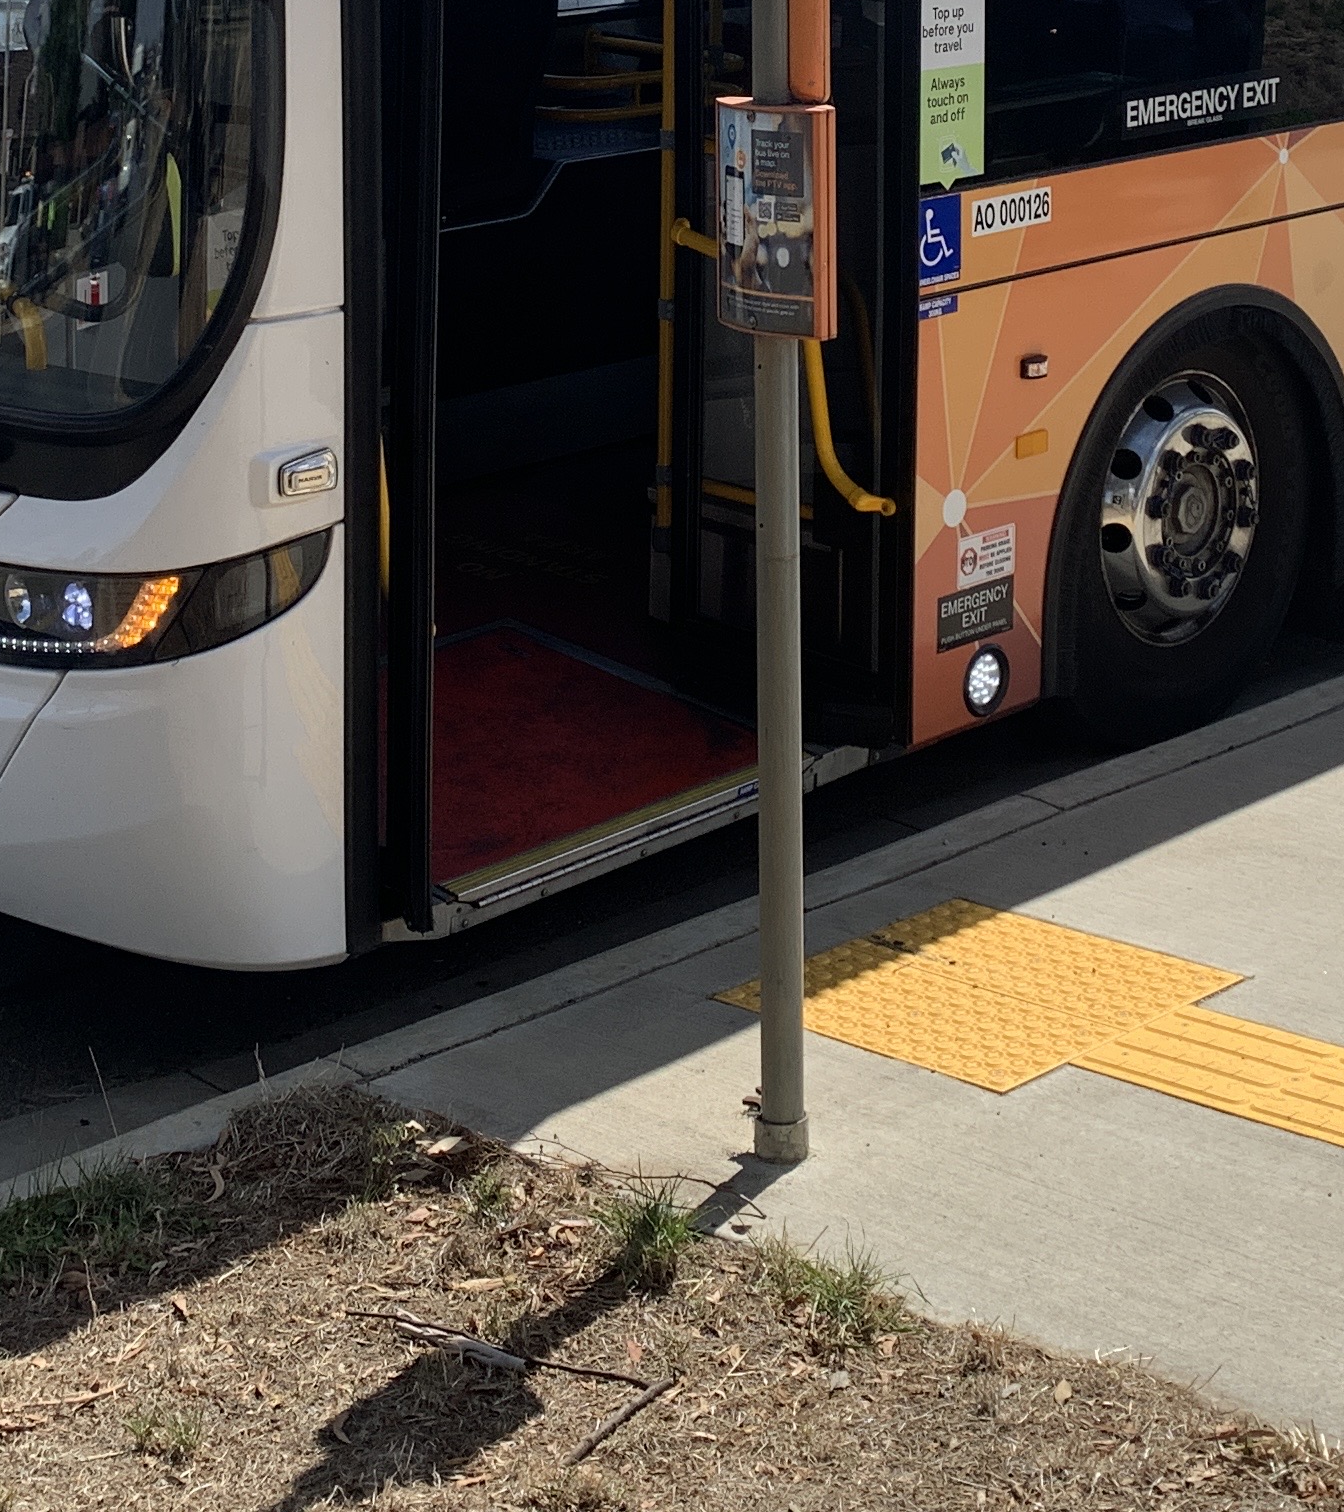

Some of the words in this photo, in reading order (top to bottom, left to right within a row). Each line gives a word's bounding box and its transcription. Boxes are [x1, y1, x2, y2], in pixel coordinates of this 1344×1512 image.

[933, 7, 950, 22] Top
[952, 7, 965, 20] up
[922, 23, 955, 38] before
[957, 23, 974, 37] you
[934, 38, 963, 54] travel
[930, 76, 965, 92] Always
[927, 92, 955, 108] touch
[957, 93, 969, 104] on
[1126, 83, 1240, 128] EMERGENCY
[1242, 77, 1281, 108] EXIT
[930, 110, 948, 125] and
[950, 107, 965, 122] off
[973, 202, 995, 233] AO
[999, 191, 1050, 226] 000126
[941, 583, 1009, 618] EMERGENCY
[962, 606, 988, 628] EXIT
